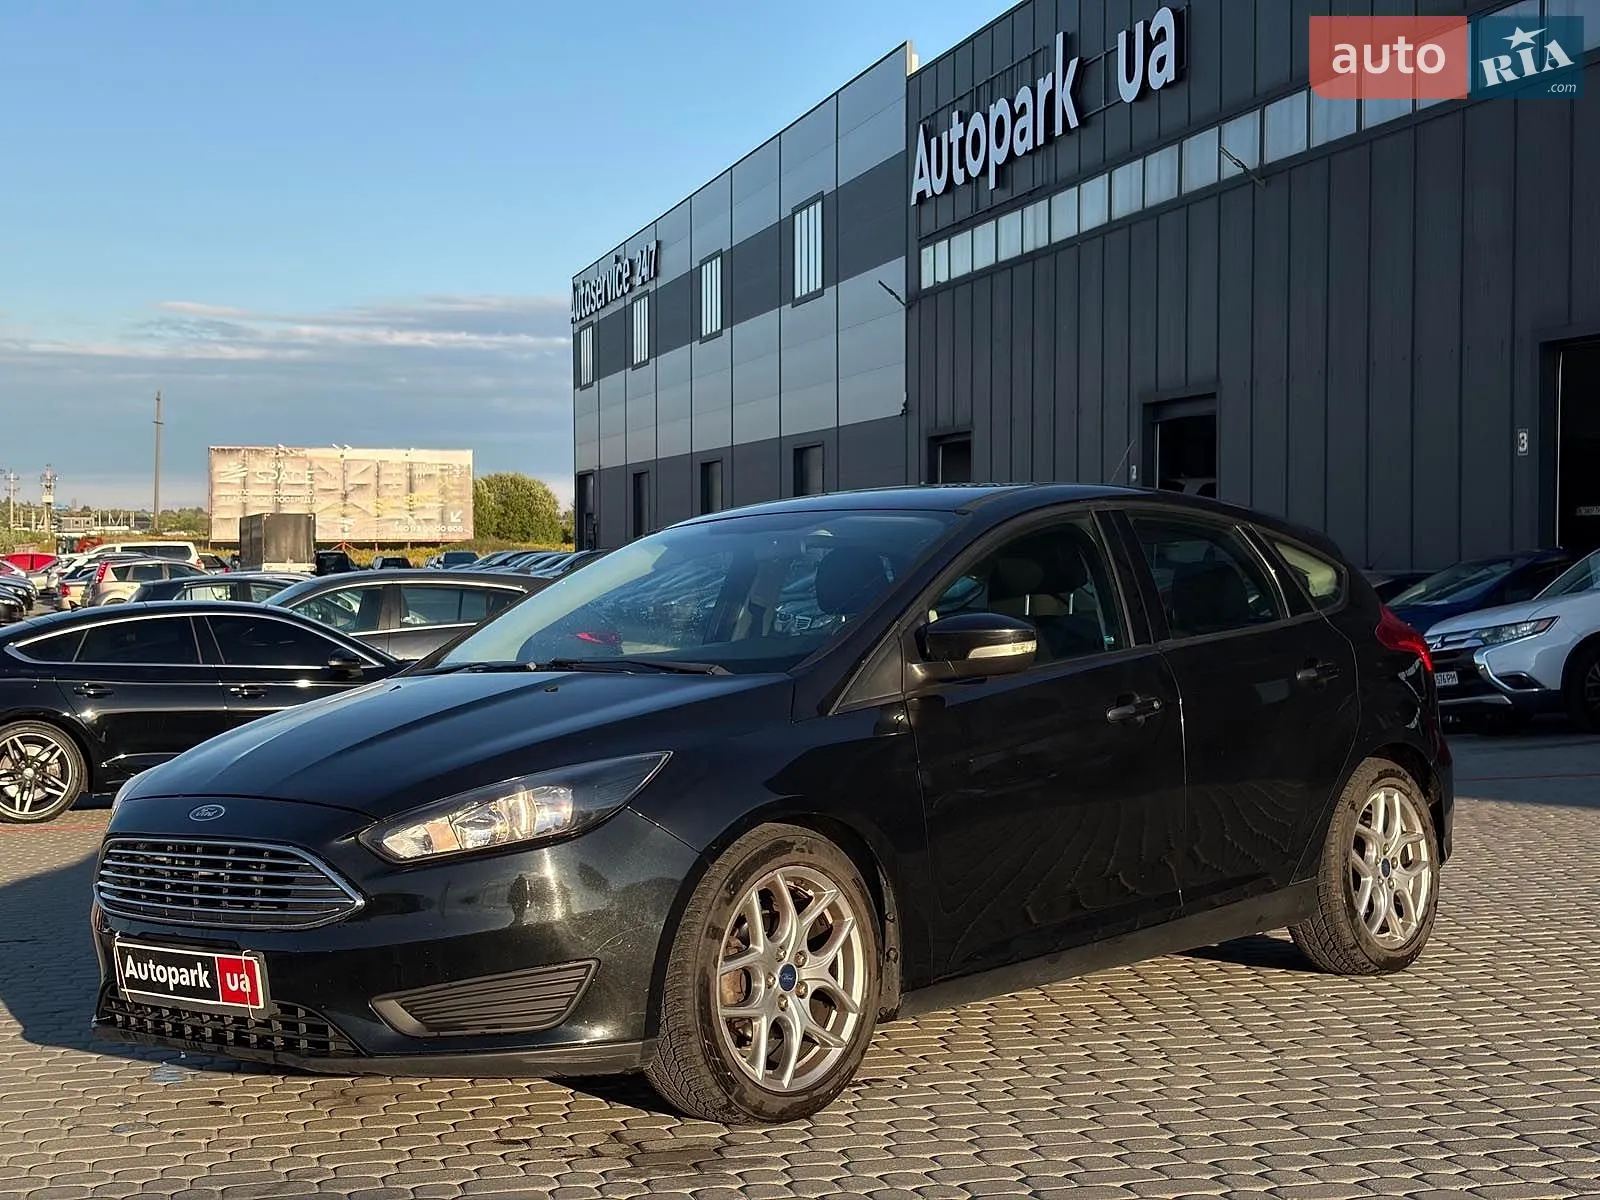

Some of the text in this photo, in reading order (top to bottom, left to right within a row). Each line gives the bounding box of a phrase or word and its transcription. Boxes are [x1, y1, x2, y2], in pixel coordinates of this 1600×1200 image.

[911, 6, 1175, 207] Autopark ua
[1519, 431, 1528, 452] 3
[125, 954, 252, 993] Autopark ua
